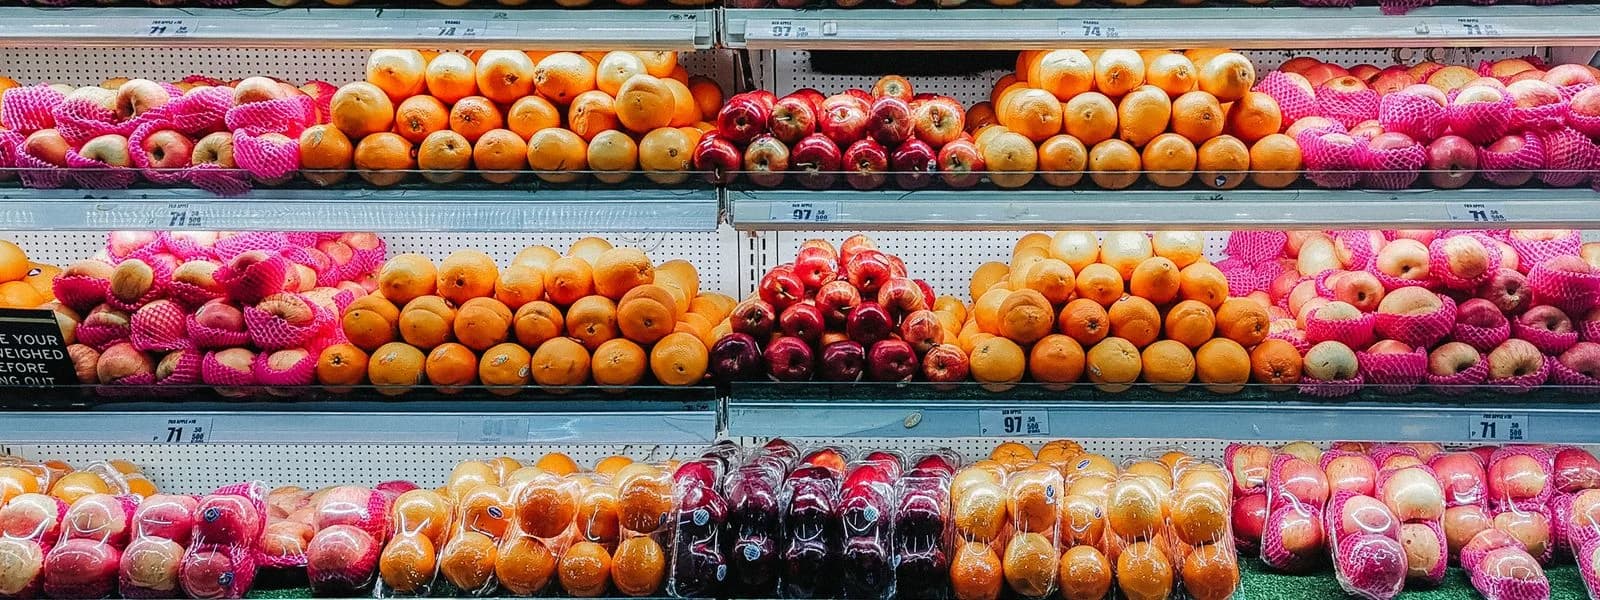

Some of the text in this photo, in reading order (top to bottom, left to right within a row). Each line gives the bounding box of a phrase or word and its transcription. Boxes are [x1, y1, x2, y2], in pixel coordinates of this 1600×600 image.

[150, 26, 167, 34] 71
[438, 27, 457, 36] 74
[772, 26, 792, 37] 97
[1083, 26, 1101, 36] 74
[1463, 24, 1482, 35] 71
[169, 211, 186, 226] 71
[792, 209, 811, 220] 97
[1469, 210, 1488, 221] 71
[12, 334, 58, 345] YOUR
[24, 376, 55, 388] OUT
[1004, 416, 1022, 433] 97
[1480, 421, 1496, 438] 71
[167, 427, 183, 442] 71
[191, 433, 204, 441] 500
